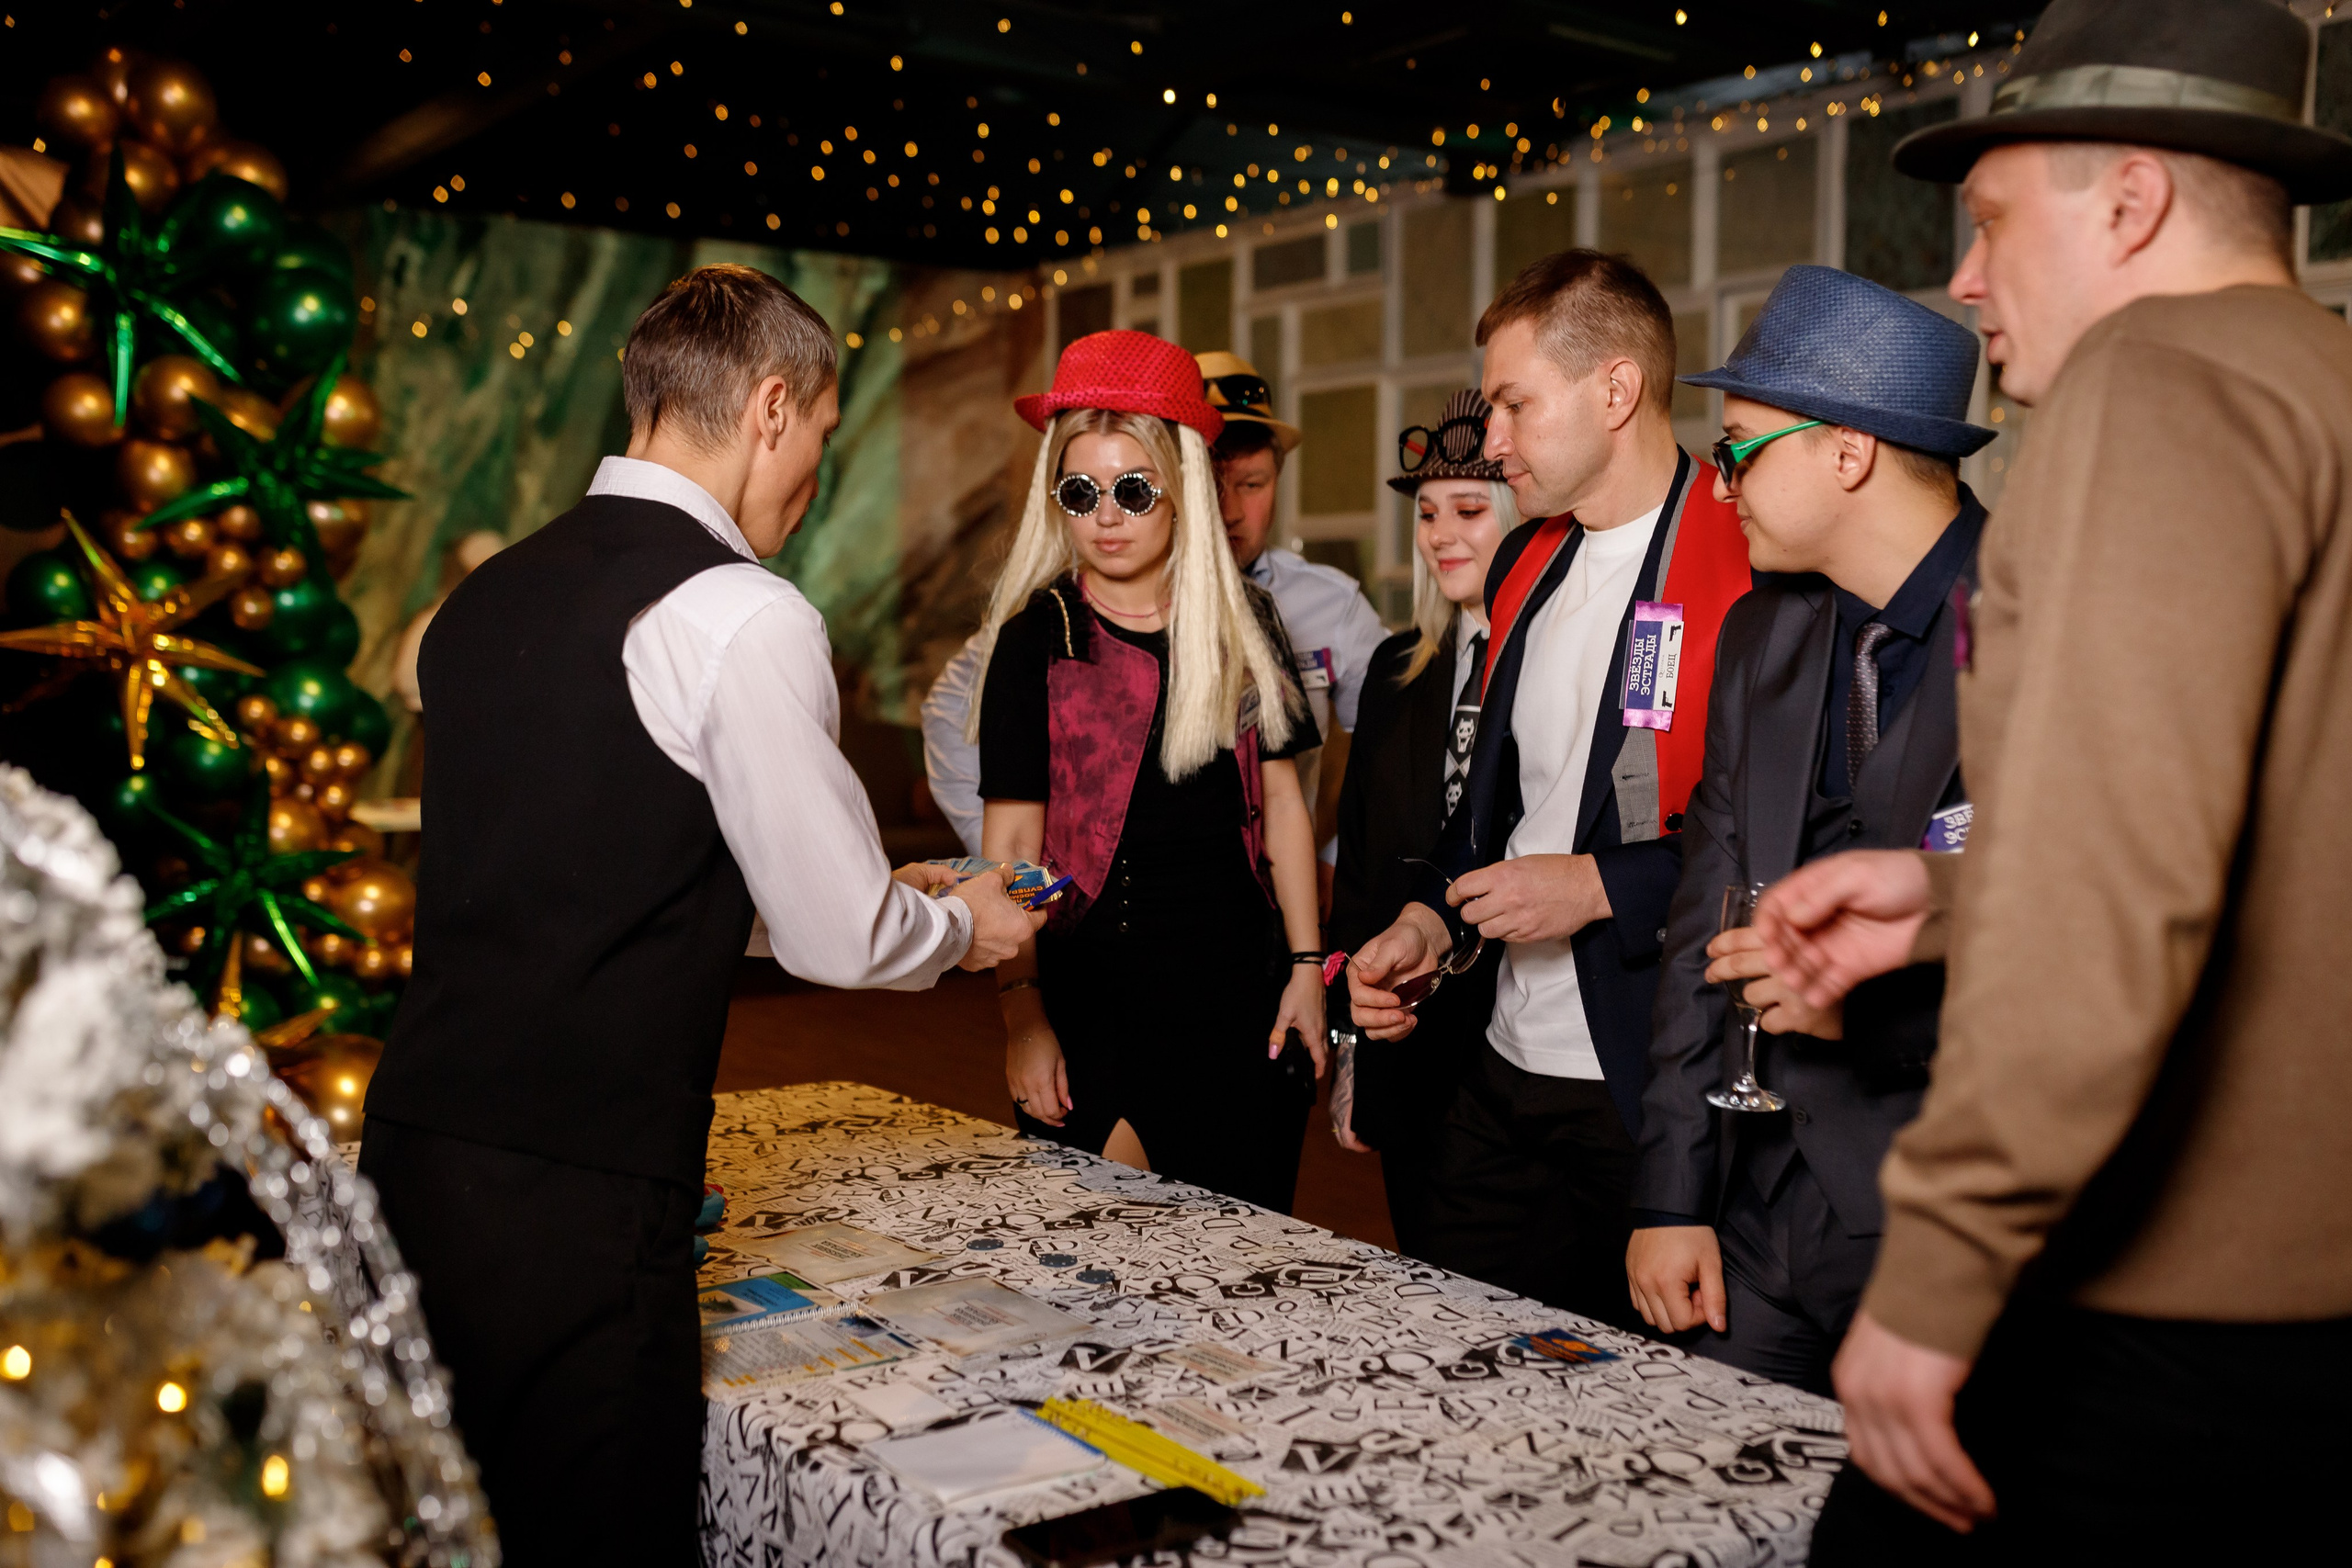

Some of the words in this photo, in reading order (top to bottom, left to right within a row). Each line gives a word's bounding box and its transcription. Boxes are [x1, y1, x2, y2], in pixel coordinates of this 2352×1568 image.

[1629, 637, 1645, 692] ЗВЁЗДЫ
[1641, 634, 1657, 696] ЭСТРАДЫ
[1666, 653, 1678, 679] БОЕЦ
